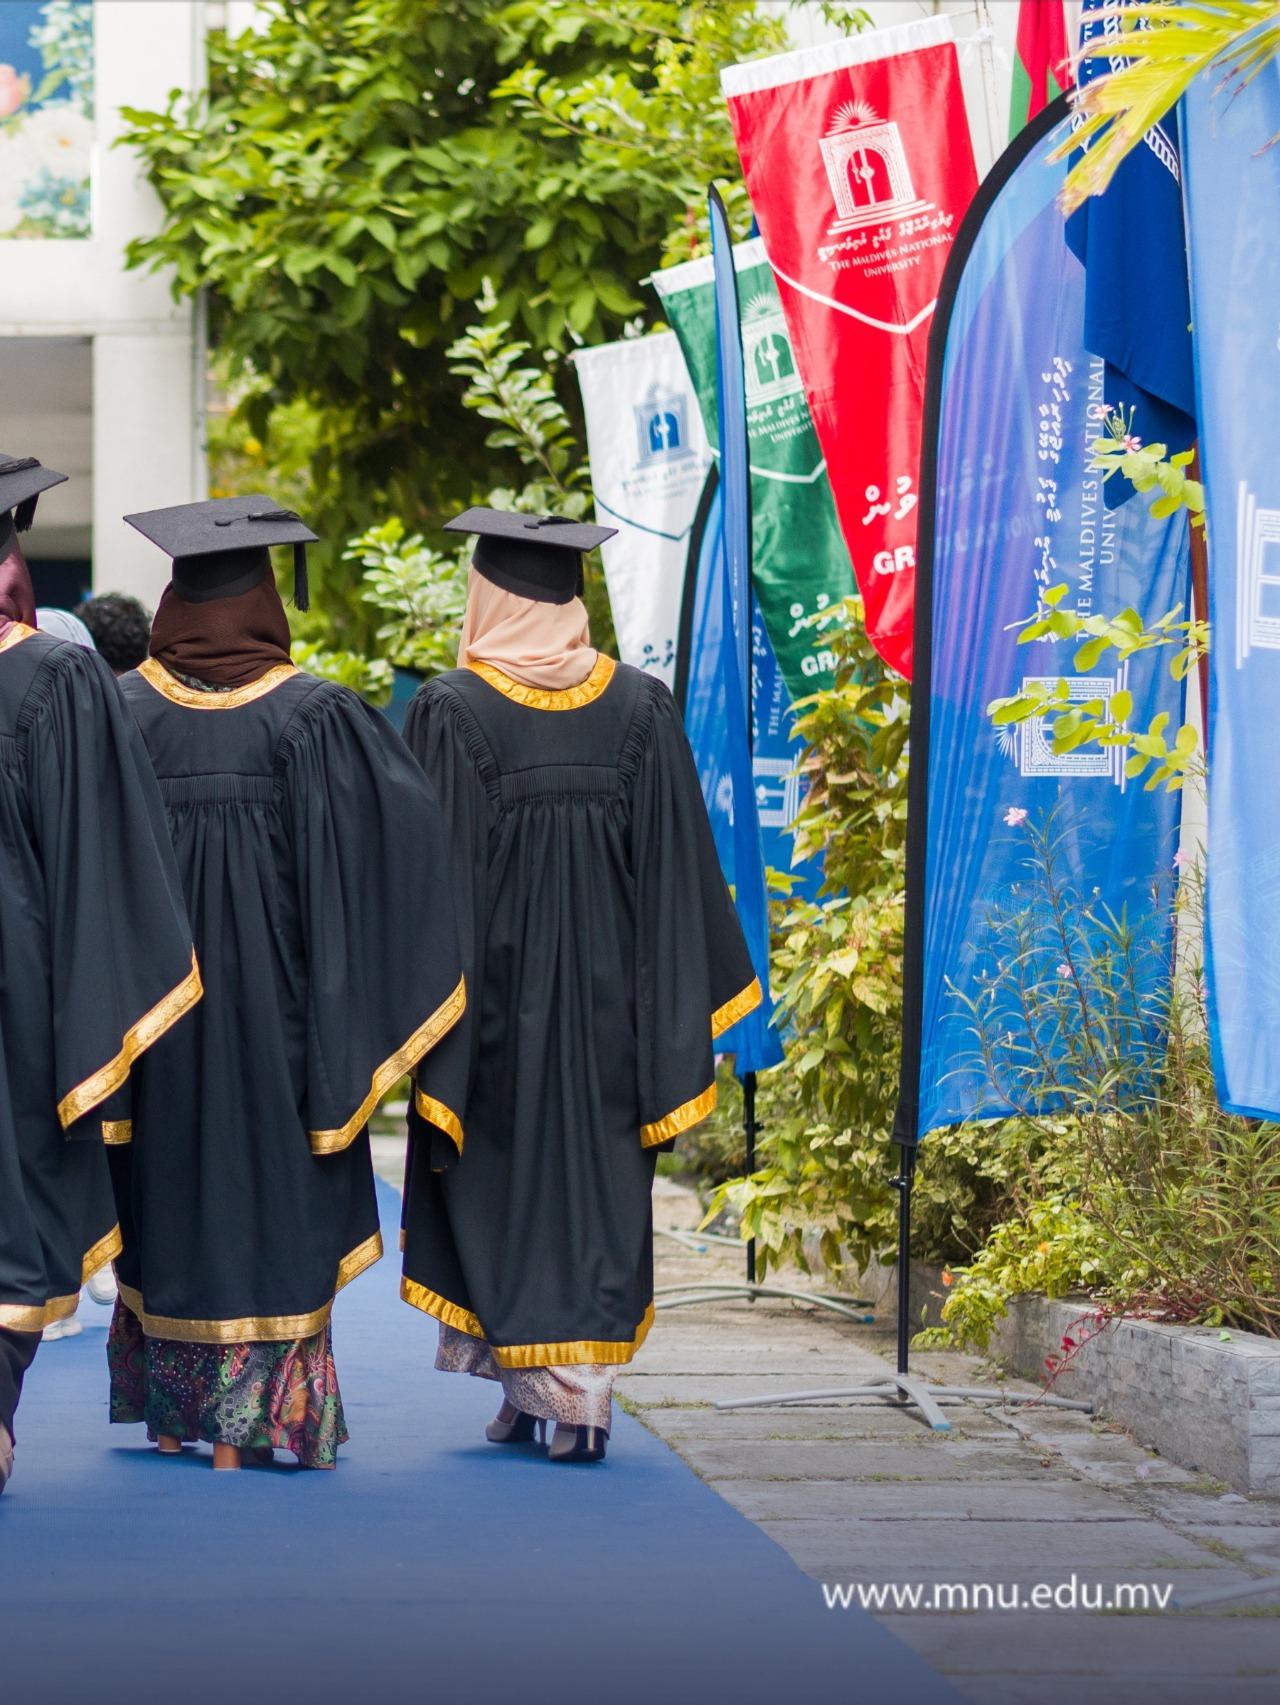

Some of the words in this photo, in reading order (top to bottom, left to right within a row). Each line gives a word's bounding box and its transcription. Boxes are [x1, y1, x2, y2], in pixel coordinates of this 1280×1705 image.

[829, 258, 851, 272] THE
[852, 250, 897, 268] MALDIVES
[899, 233, 954, 257] NATIONAL
[863, 256, 921, 278] UNIVERSITY
[1078, 480, 1098, 592] MALDIVES
